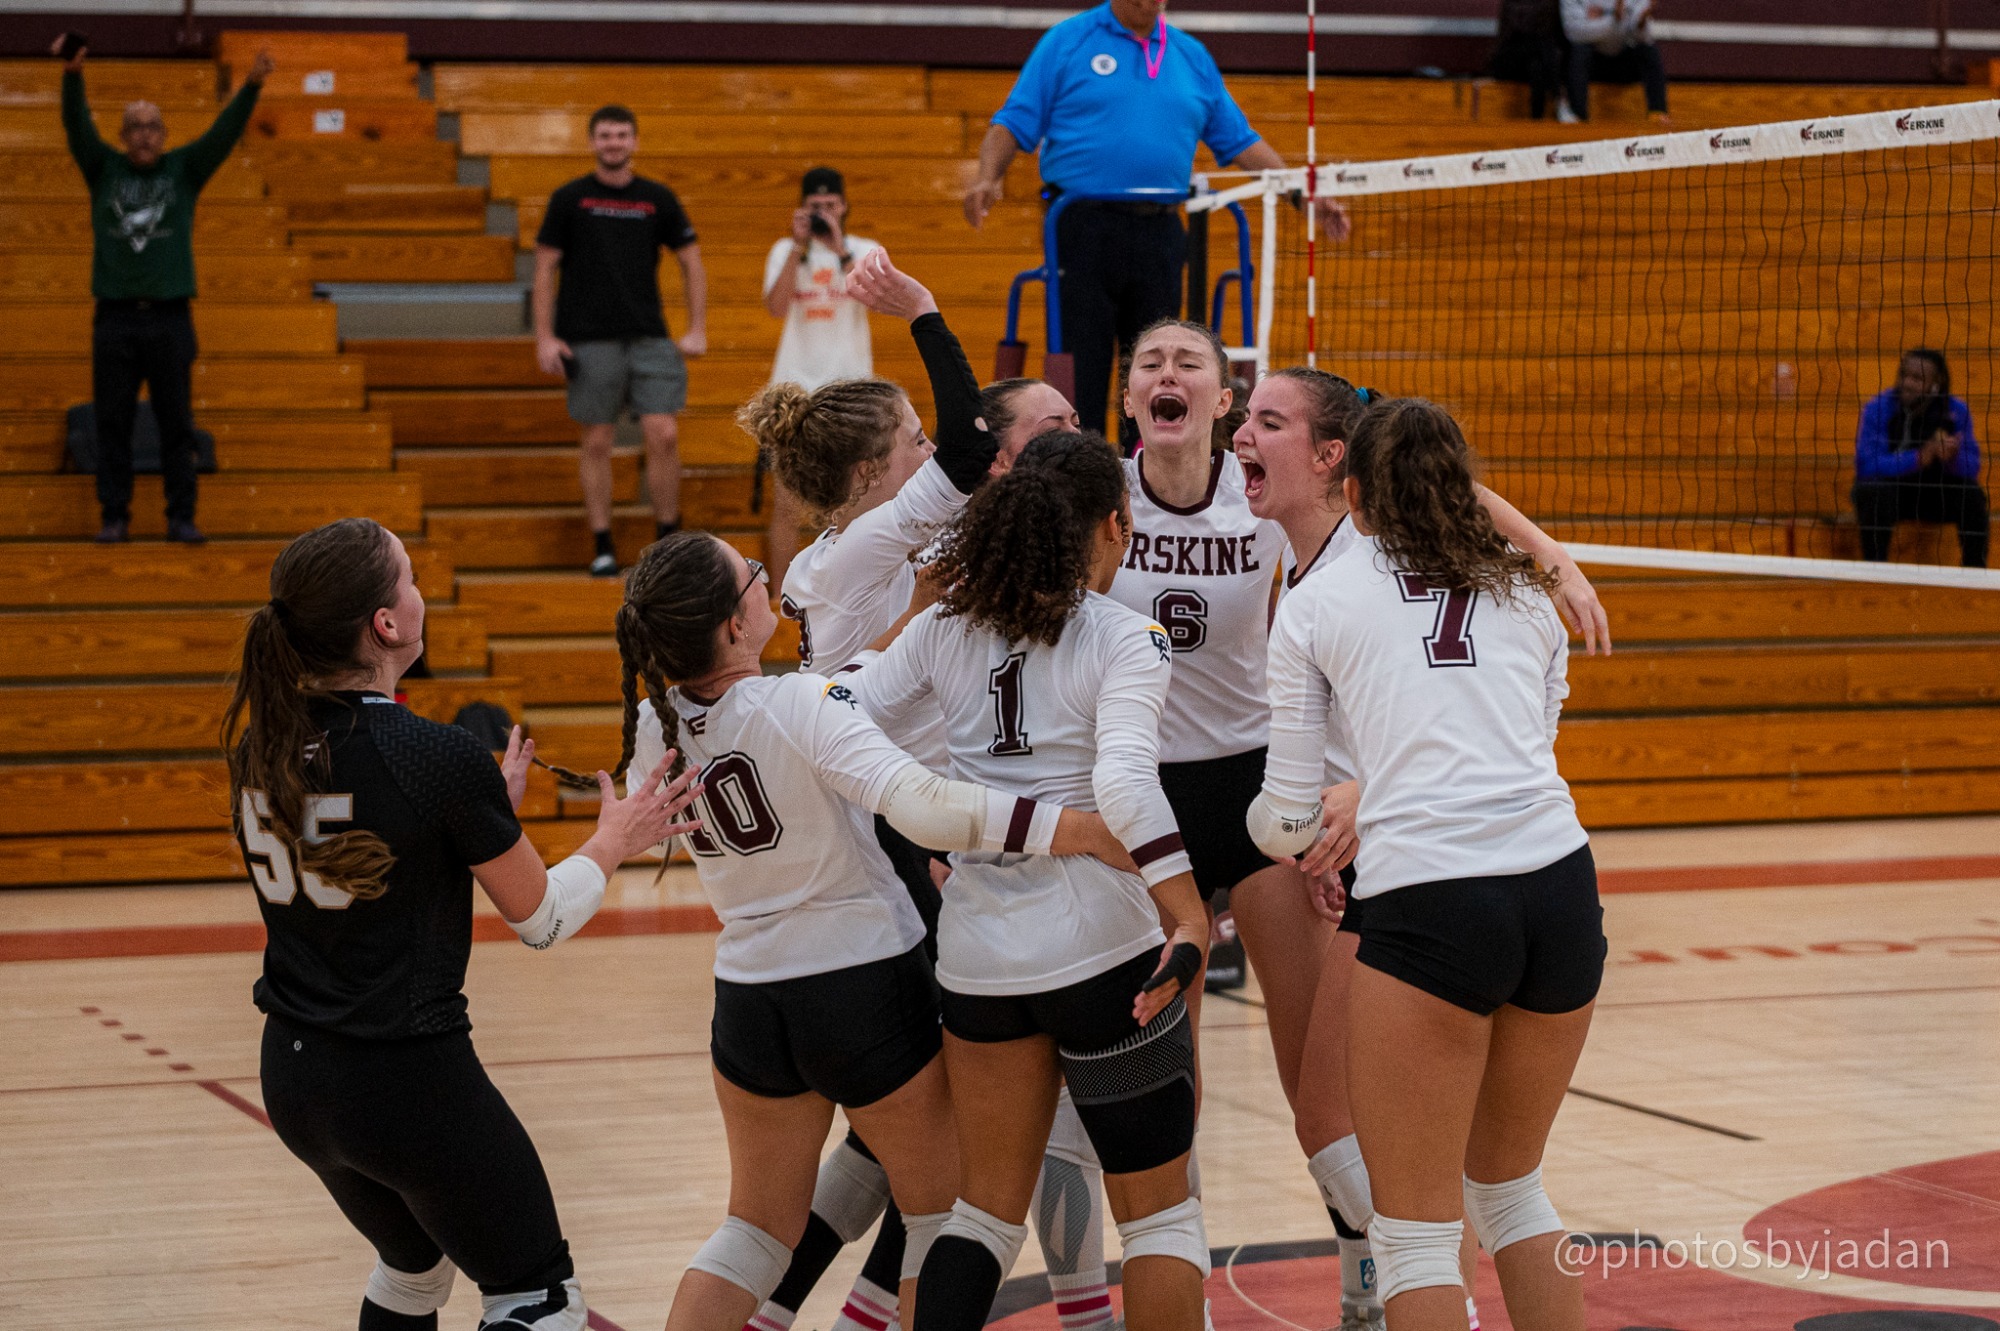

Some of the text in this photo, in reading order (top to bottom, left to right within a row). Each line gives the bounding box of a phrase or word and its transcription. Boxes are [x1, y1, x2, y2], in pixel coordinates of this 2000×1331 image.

[1119, 531, 1260, 577] RSKINE
[1153, 588, 1209, 653] 6
[1394, 569, 1478, 669] 7
[987, 651, 1034, 757] 1
[241, 785, 354, 910] 55
